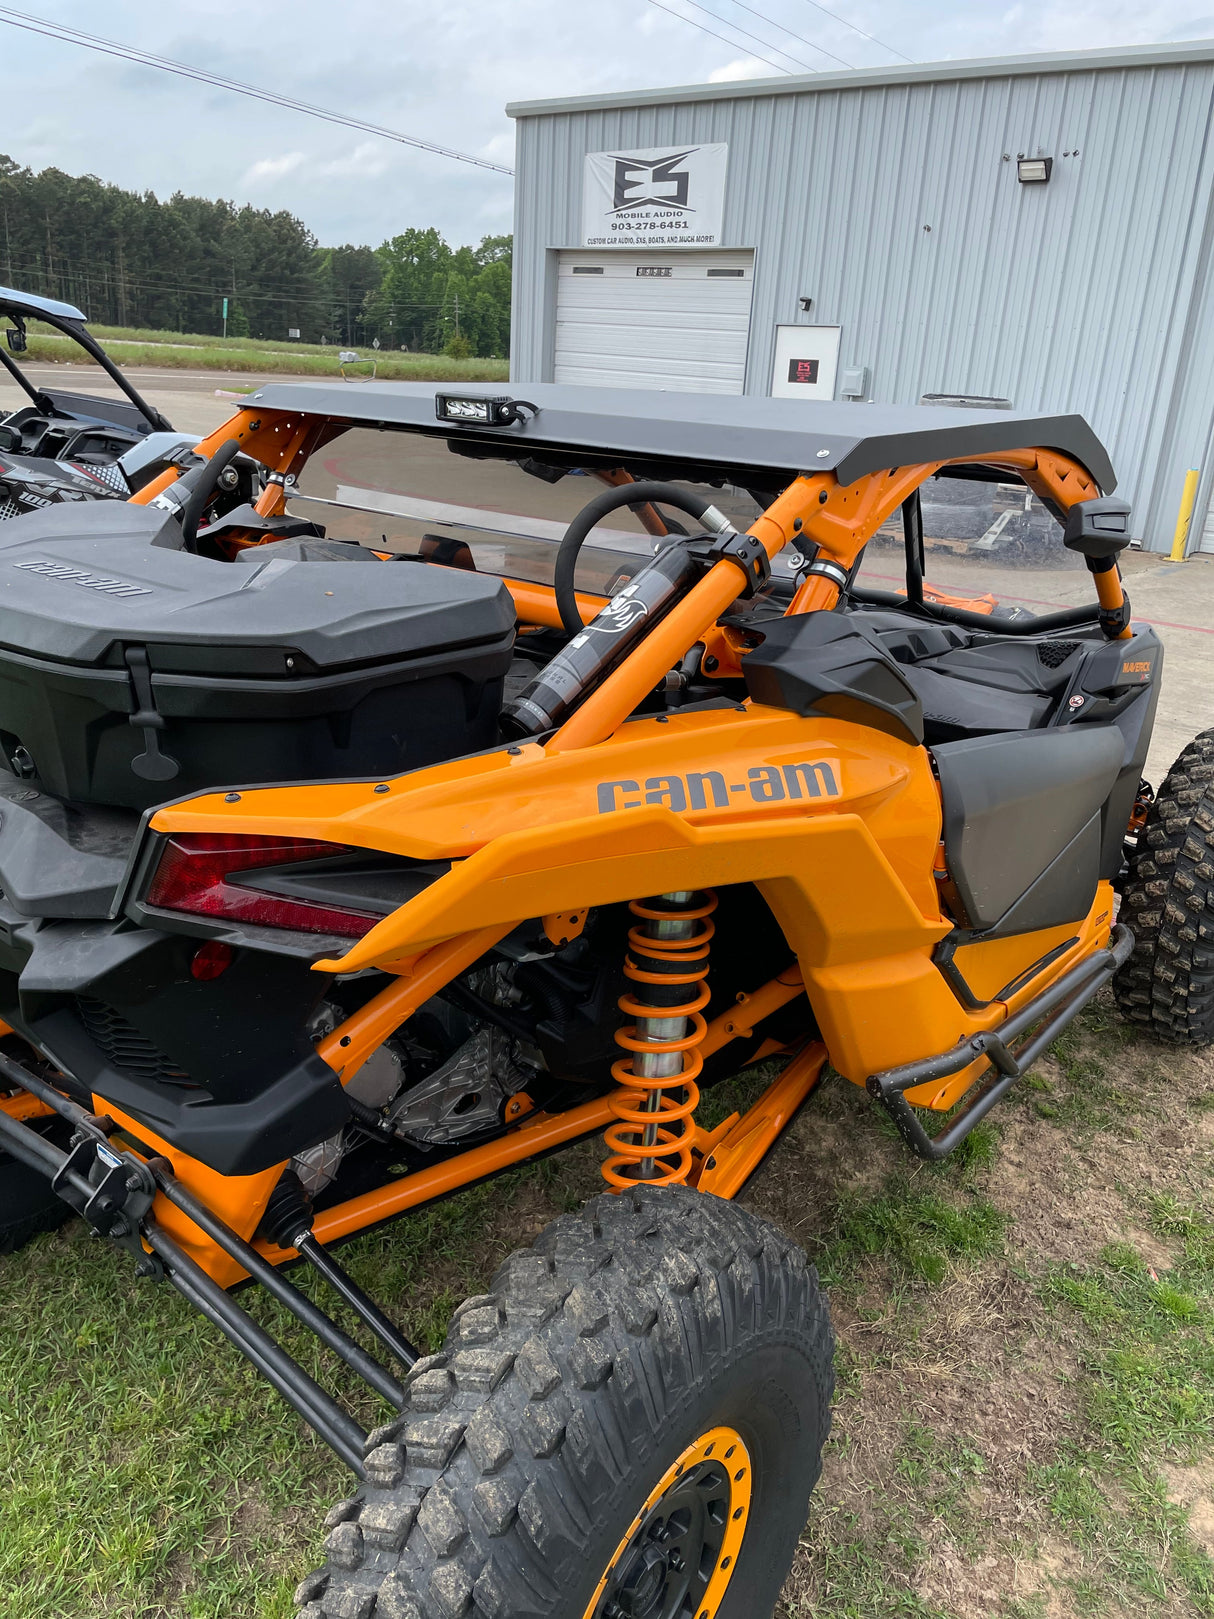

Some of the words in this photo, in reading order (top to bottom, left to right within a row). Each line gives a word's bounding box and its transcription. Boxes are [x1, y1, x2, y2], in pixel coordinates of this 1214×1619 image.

[611, 221, 688, 230] 903-278-6451
[587, 237, 606, 245] CUSTOM
[607, 237, 617, 245] CAR
[666, 235, 678, 244] AND
[679, 235, 695, 244] MUCH
[696, 234, 715, 243] MORE!
[12, 560, 154, 598] can-am
[1122, 661, 1151, 673] MAVERICK
[597, 761, 839, 814] can-am
